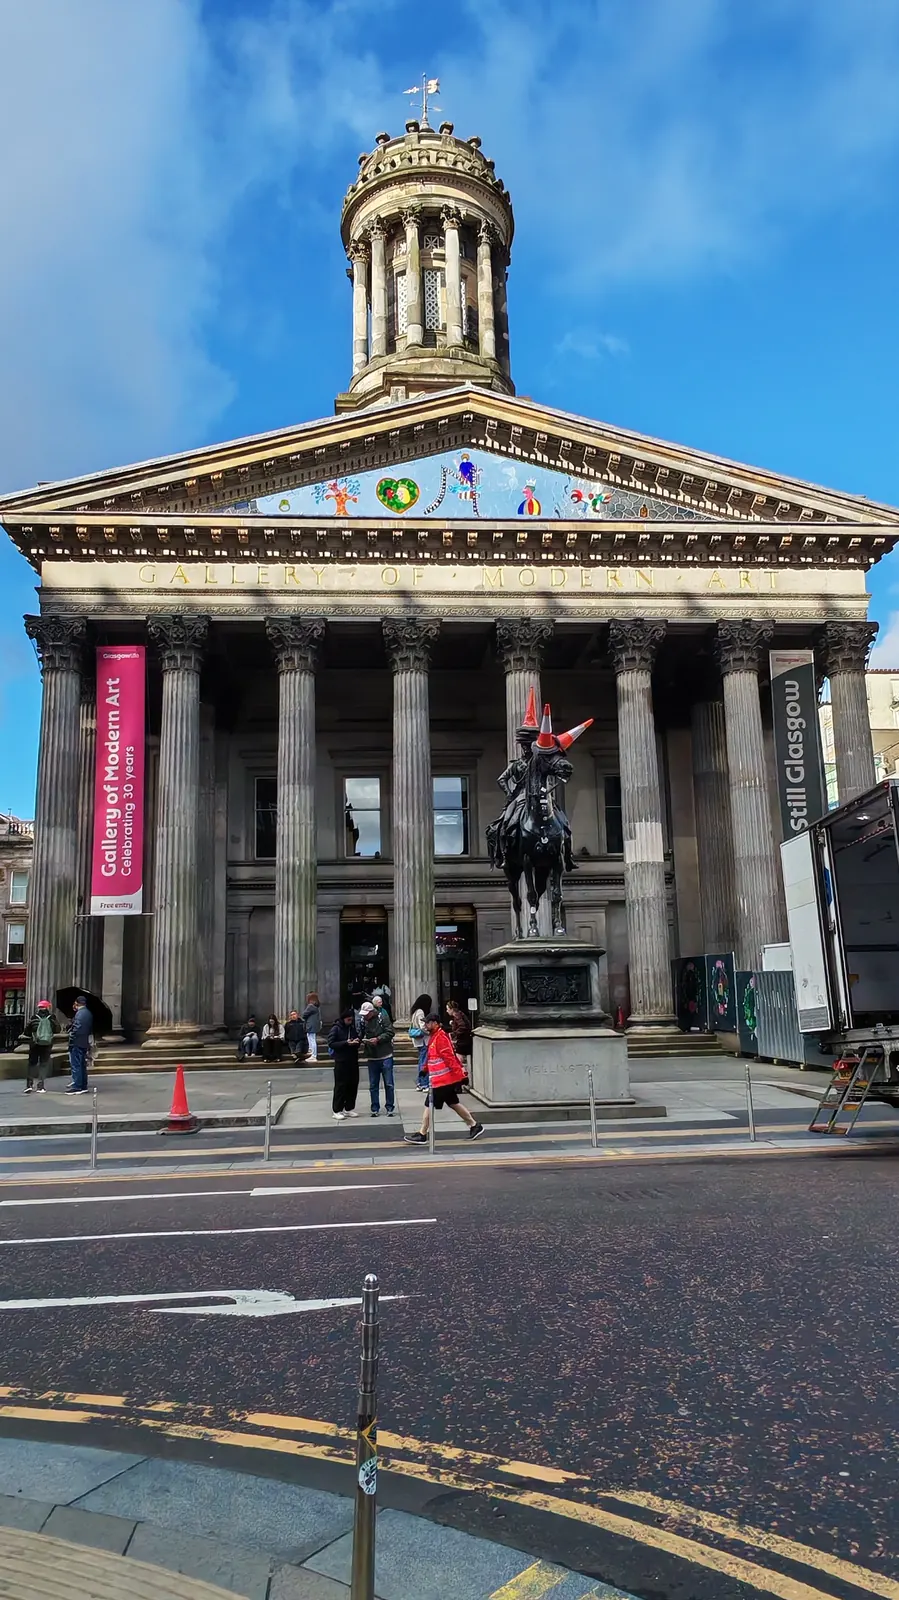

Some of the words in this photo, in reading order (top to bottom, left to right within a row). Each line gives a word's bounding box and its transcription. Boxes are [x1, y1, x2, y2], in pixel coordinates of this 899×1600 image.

[138, 565, 327, 584] GALLERY
[381, 567, 425, 585] OF
[481, 568, 655, 588] MODERN
[707, 570, 780, 589] ART
[106, 678, 120, 706] Art
[104, 710, 120, 781] Modern
[784, 680, 806, 783] Glasgow
[126, 746, 136, 781] years
[103, 784, 119, 804] of
[123, 784, 133, 799] 30
[786, 788, 809, 830] Still
[101, 808, 121, 876] Gallery
[121, 803, 135, 876] Celebrating
[115, 902, 133, 910] entry
